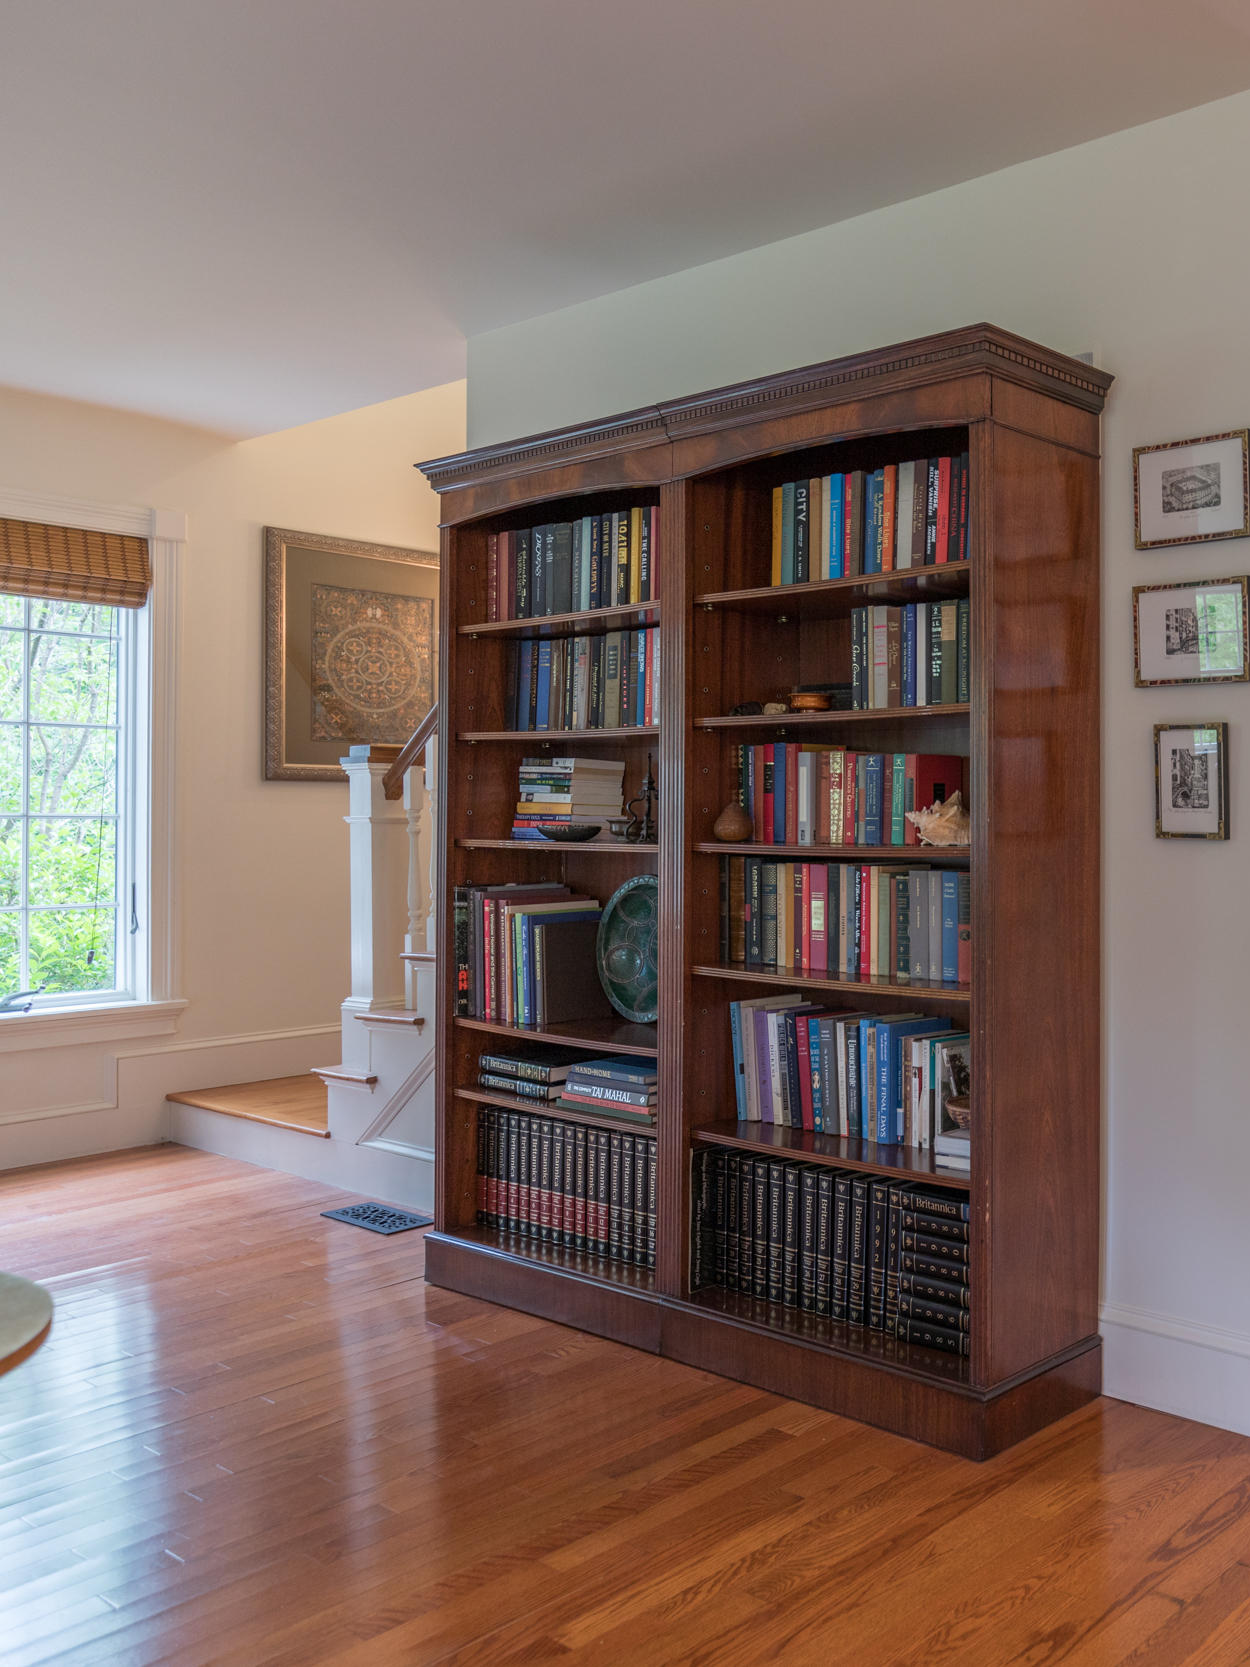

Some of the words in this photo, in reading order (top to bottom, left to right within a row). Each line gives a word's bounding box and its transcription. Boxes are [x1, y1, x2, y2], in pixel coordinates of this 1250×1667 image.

[797, 488, 807, 522] CITY
[852, 645, 860, 662] Gap
[848, 1039, 857, 1087] Untouchable
[489, 1078, 515, 1090] Britannica
[592, 1086, 603, 1098] TAJ
[603, 1089, 632, 1103] MAHAL
[773, 1188, 781, 1238] Britannica
[820, 1199, 828, 1250] Britannica
[916, 1198, 957, 1215] Britannica
[837, 1202, 845, 1254] Britannica
[854, 1206, 862, 1258] Britannica
